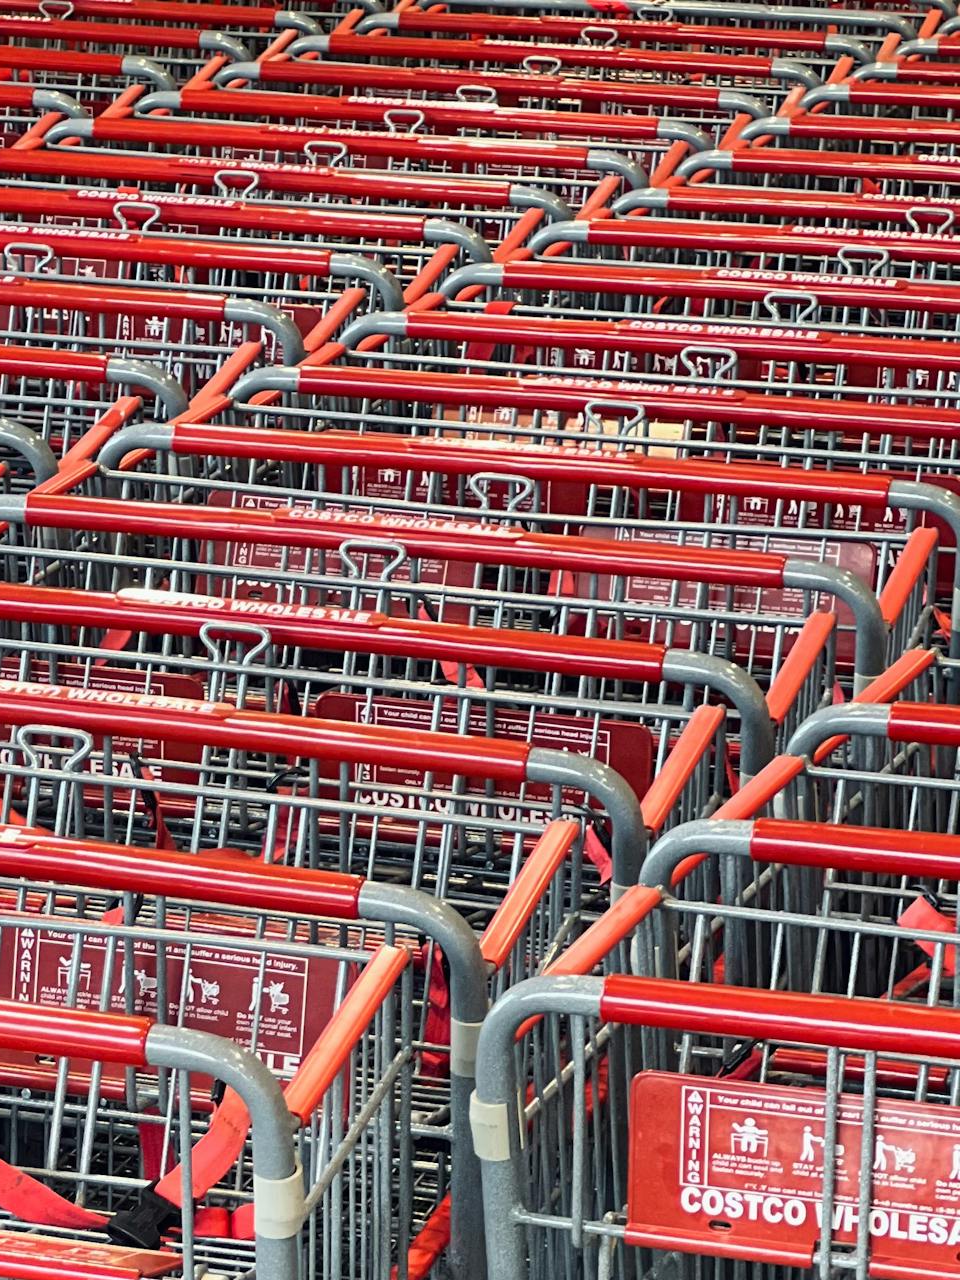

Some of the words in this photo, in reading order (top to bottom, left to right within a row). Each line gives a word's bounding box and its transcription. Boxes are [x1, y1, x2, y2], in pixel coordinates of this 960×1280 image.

[76, 189, 140, 200] COSTCO
[142, 194, 236, 208] WHOLESALE
[862, 193, 926, 203] COSTCO
[32, 226, 130, 240] WHOLESALE
[792, 226, 860, 236] COSTCO
[862, 229, 960, 242] WHOLESALE
[717, 270, 788, 280] COSTCO
[791, 274, 898, 288] WHOLESALE
[630, 320, 704, 332] COSTCO
[706, 325, 820, 339] WHOLESALE
[290, 509, 374, 524] COSTCO
[380, 517, 512, 536] WHOLESALE
[66, 688, 215, 713] WHOLESALE
[383, 709, 400, 718] Your
[47, 930, 69, 942] Your
[88, 936, 103, 944] can
[222, 953, 250, 964] serious
[273, 960, 299, 972] injury.
[19, 938, 34, 1002] WARNIN
[718, 1095, 740, 1106] Your
[740, 1098, 762, 1108] child
[764, 1102, 780, 1110] can
[782, 1102, 796, 1112] fall
[797, 1105, 812, 1114] out
[814, 1108, 824, 1116] of
[842, 1111, 860, 1120] cart
[880, 1116, 906, 1126] suffer
[916, 1120, 950, 1132] serious
[688, 1103, 704, 1184] WARNING
[712, 1152, 747, 1164] ALWAYS
[792, 1162, 814, 1172] STAY
[936, 1180, 948, 1188] Do
[680, 1187, 806, 1226] COSTCO
